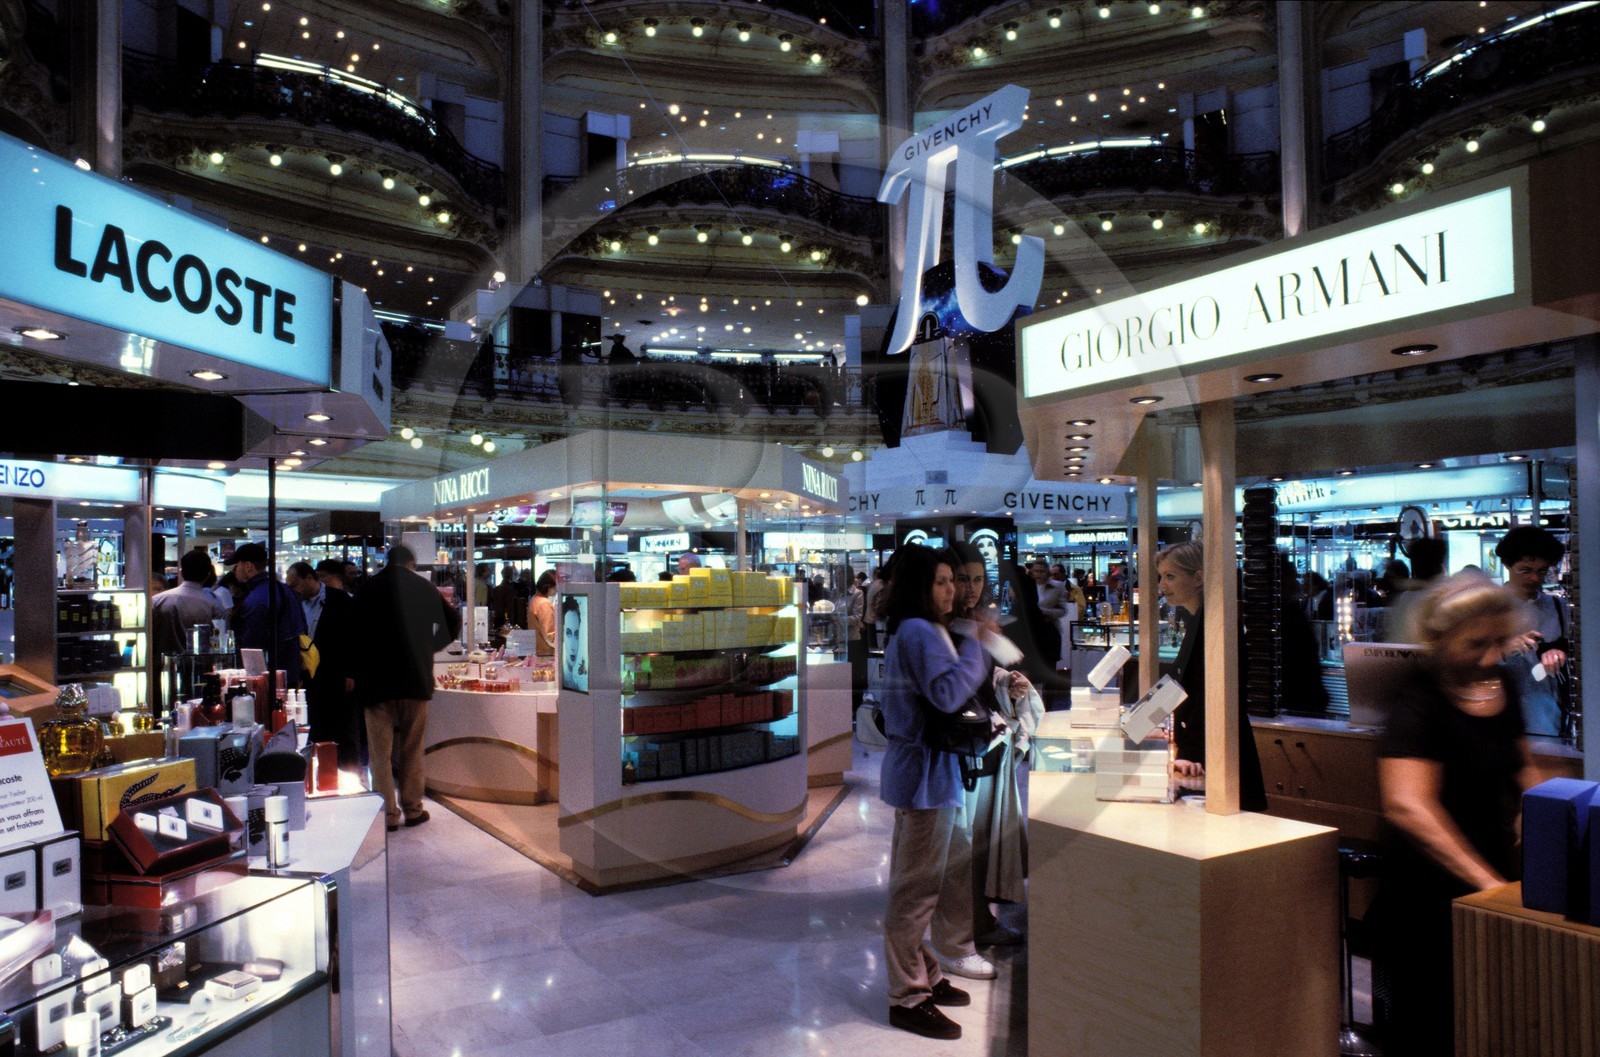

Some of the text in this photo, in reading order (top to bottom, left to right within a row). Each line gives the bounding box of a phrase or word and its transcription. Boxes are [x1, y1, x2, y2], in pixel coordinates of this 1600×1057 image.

[904, 103, 993, 161] GIVENCHY
[54, 204, 297, 345] LACOSTE
[1060, 229, 1450, 374] GIORGIO ARMANI
[433, 467, 490, 506] NINA RICCI
[802, 462, 838, 503] NINA RICCI
[1003, 492, 1112, 512] GIVENCHY
[1068, 533, 1096, 543] SONIA
[7, 825, 16, 833] set
